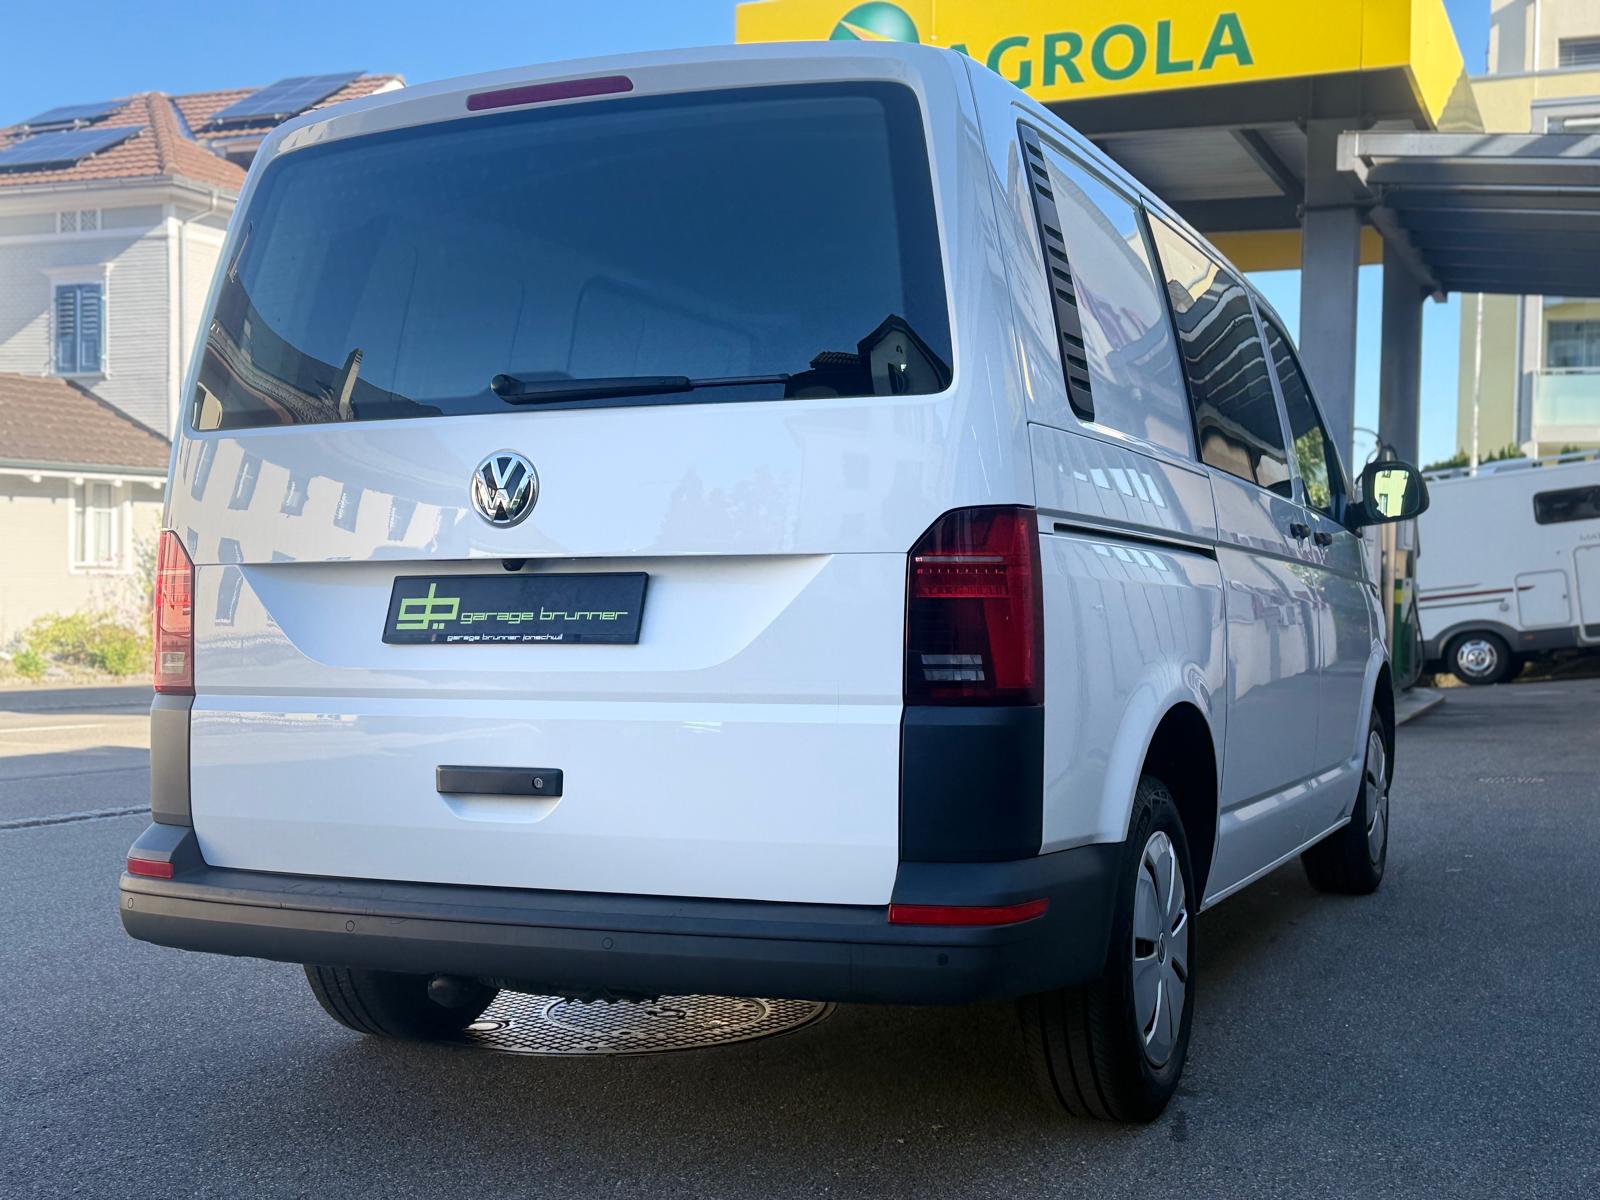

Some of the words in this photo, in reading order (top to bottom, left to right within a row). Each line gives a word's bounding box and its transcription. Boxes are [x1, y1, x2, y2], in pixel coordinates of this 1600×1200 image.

[949, 12, 1255, 89] GROLA
[460, 611, 534, 625] garage
[539, 606, 629, 621] brunner
[447, 634, 480, 642] garage
[481, 633, 521, 641] brunner
